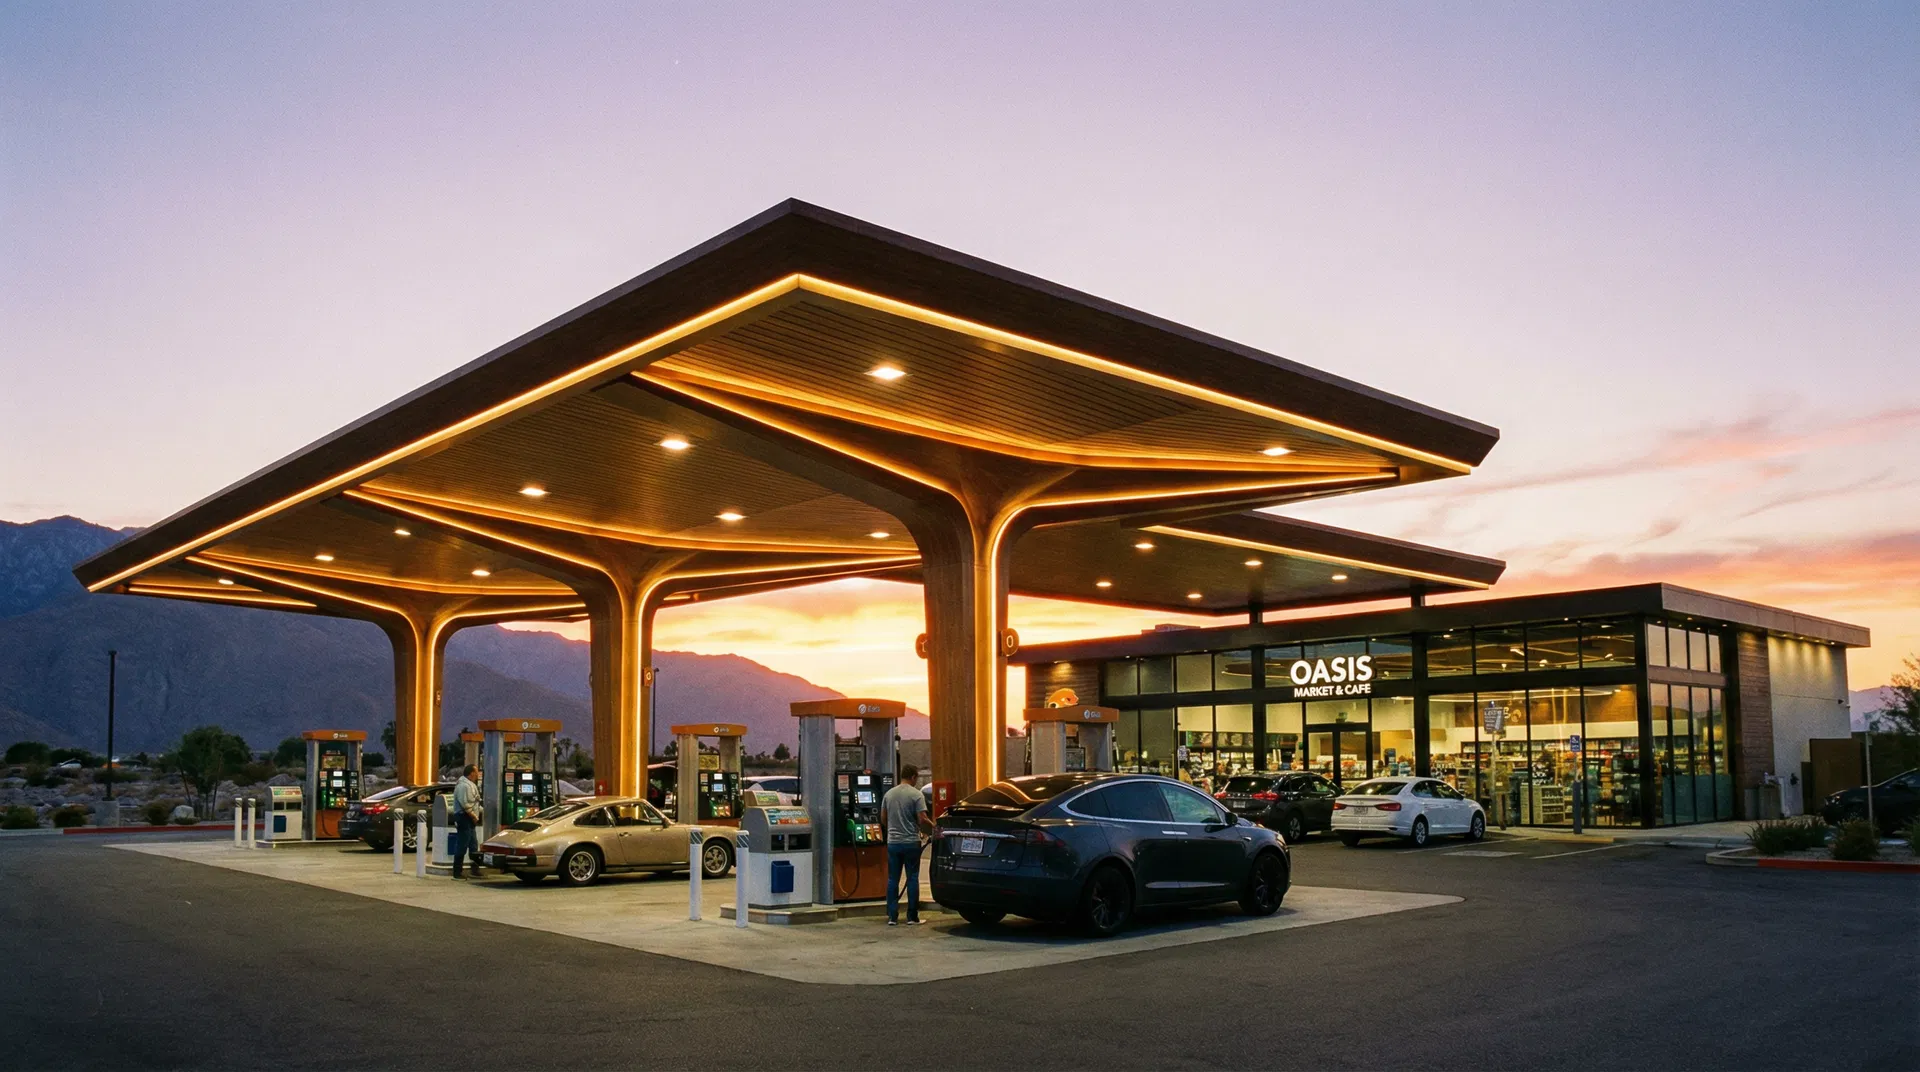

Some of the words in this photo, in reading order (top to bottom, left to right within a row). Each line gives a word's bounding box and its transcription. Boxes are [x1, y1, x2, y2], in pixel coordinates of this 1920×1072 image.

[1290, 655, 1373, 685] OASIS
[1294, 685, 1335, 698] MARKET
[1335, 684, 1344, 695] &
[1344, 683, 1372, 695] CAFE
